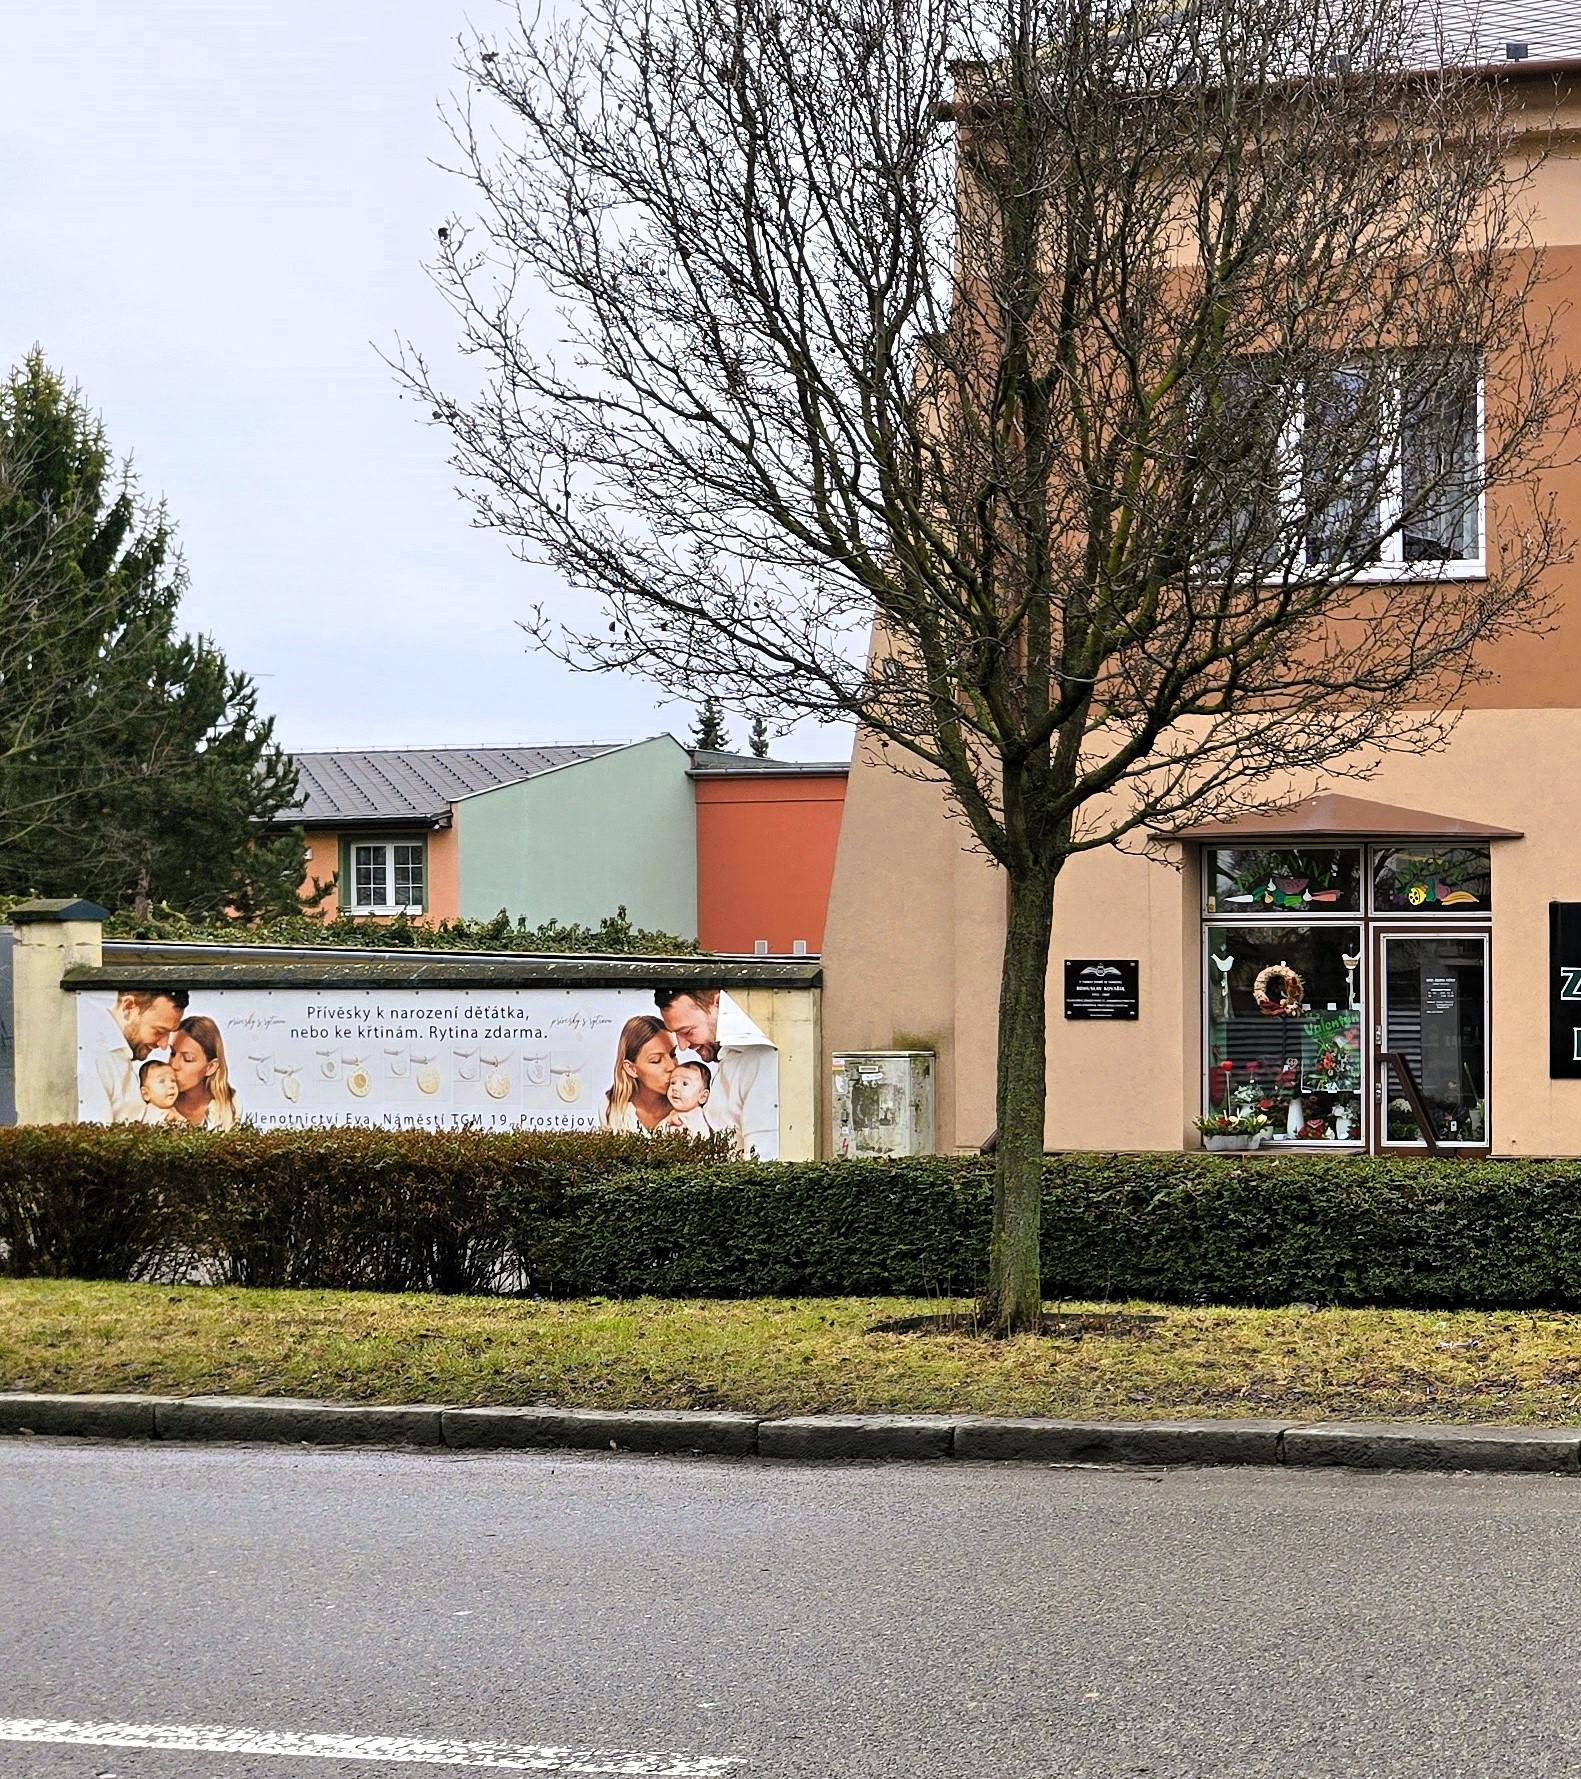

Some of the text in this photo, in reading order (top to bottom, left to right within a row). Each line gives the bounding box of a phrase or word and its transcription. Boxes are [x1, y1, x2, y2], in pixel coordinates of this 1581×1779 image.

[307, 1005, 530, 1022] Přívěsky k narození děťátka,
[290, 1025, 549, 1042] nebo ke křtinám. Rytina zdarma.
[383, 1112, 445, 1126] Náměstí
[450, 1113, 483, 1126] TGM
[520, 1113, 595, 1128] Prostějov
